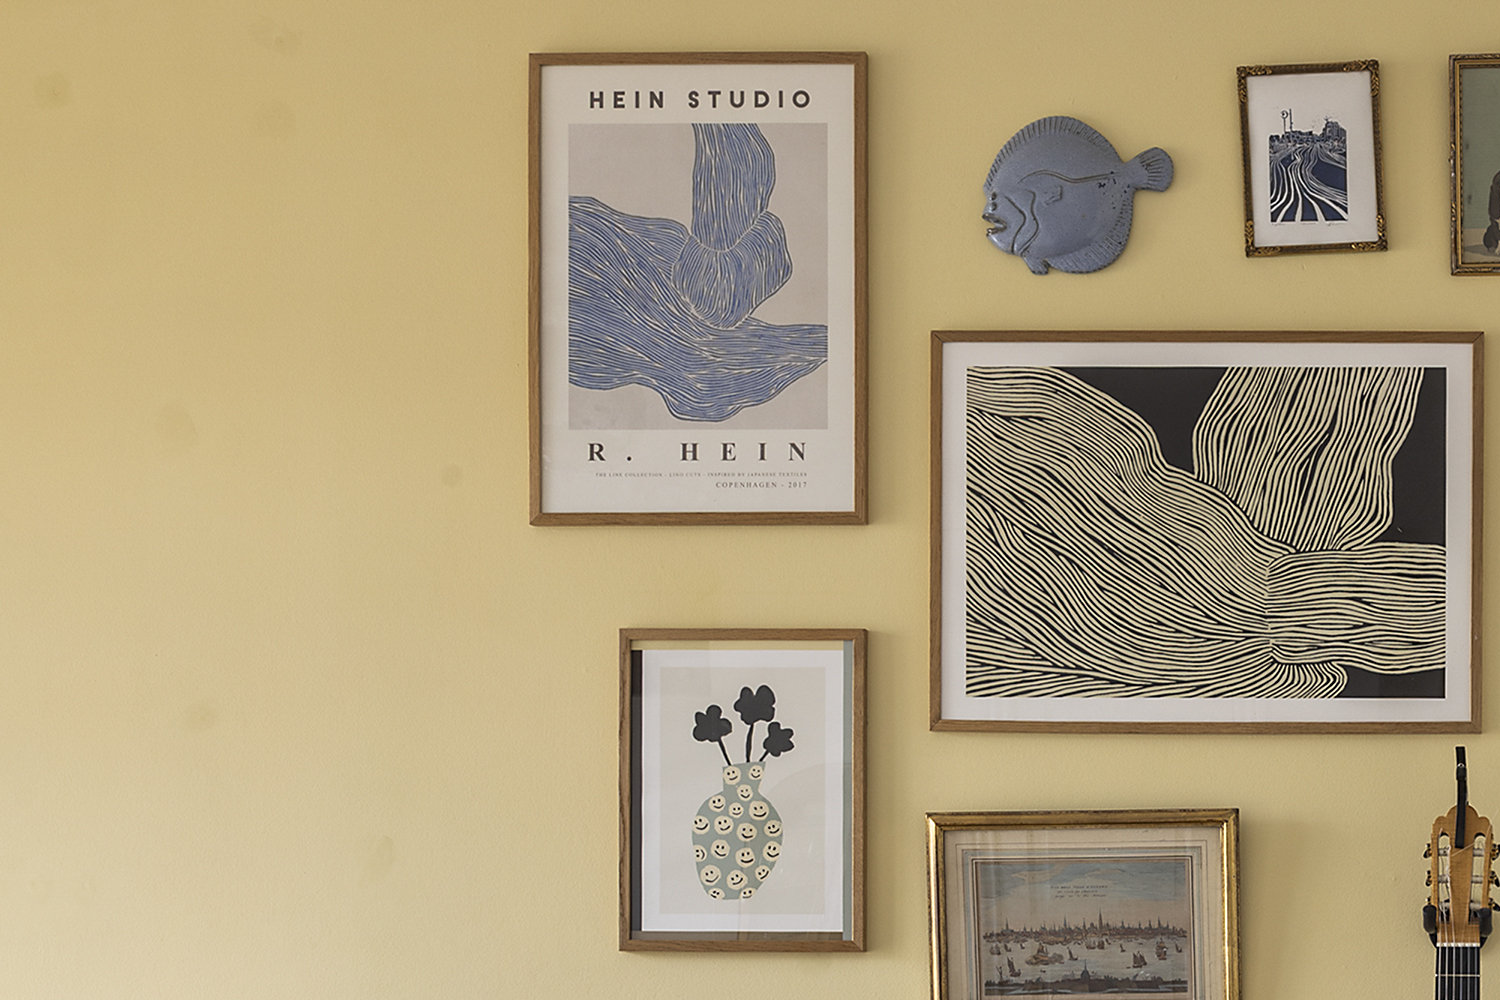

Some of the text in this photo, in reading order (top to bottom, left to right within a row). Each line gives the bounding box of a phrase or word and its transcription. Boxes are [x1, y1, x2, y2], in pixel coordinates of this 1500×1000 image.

[589, 89, 811, 109] HEIN STUDIO
[587, 442, 807, 462] R. HEIN
[715, 481, 808, 489] COPENHAGEN 2017
